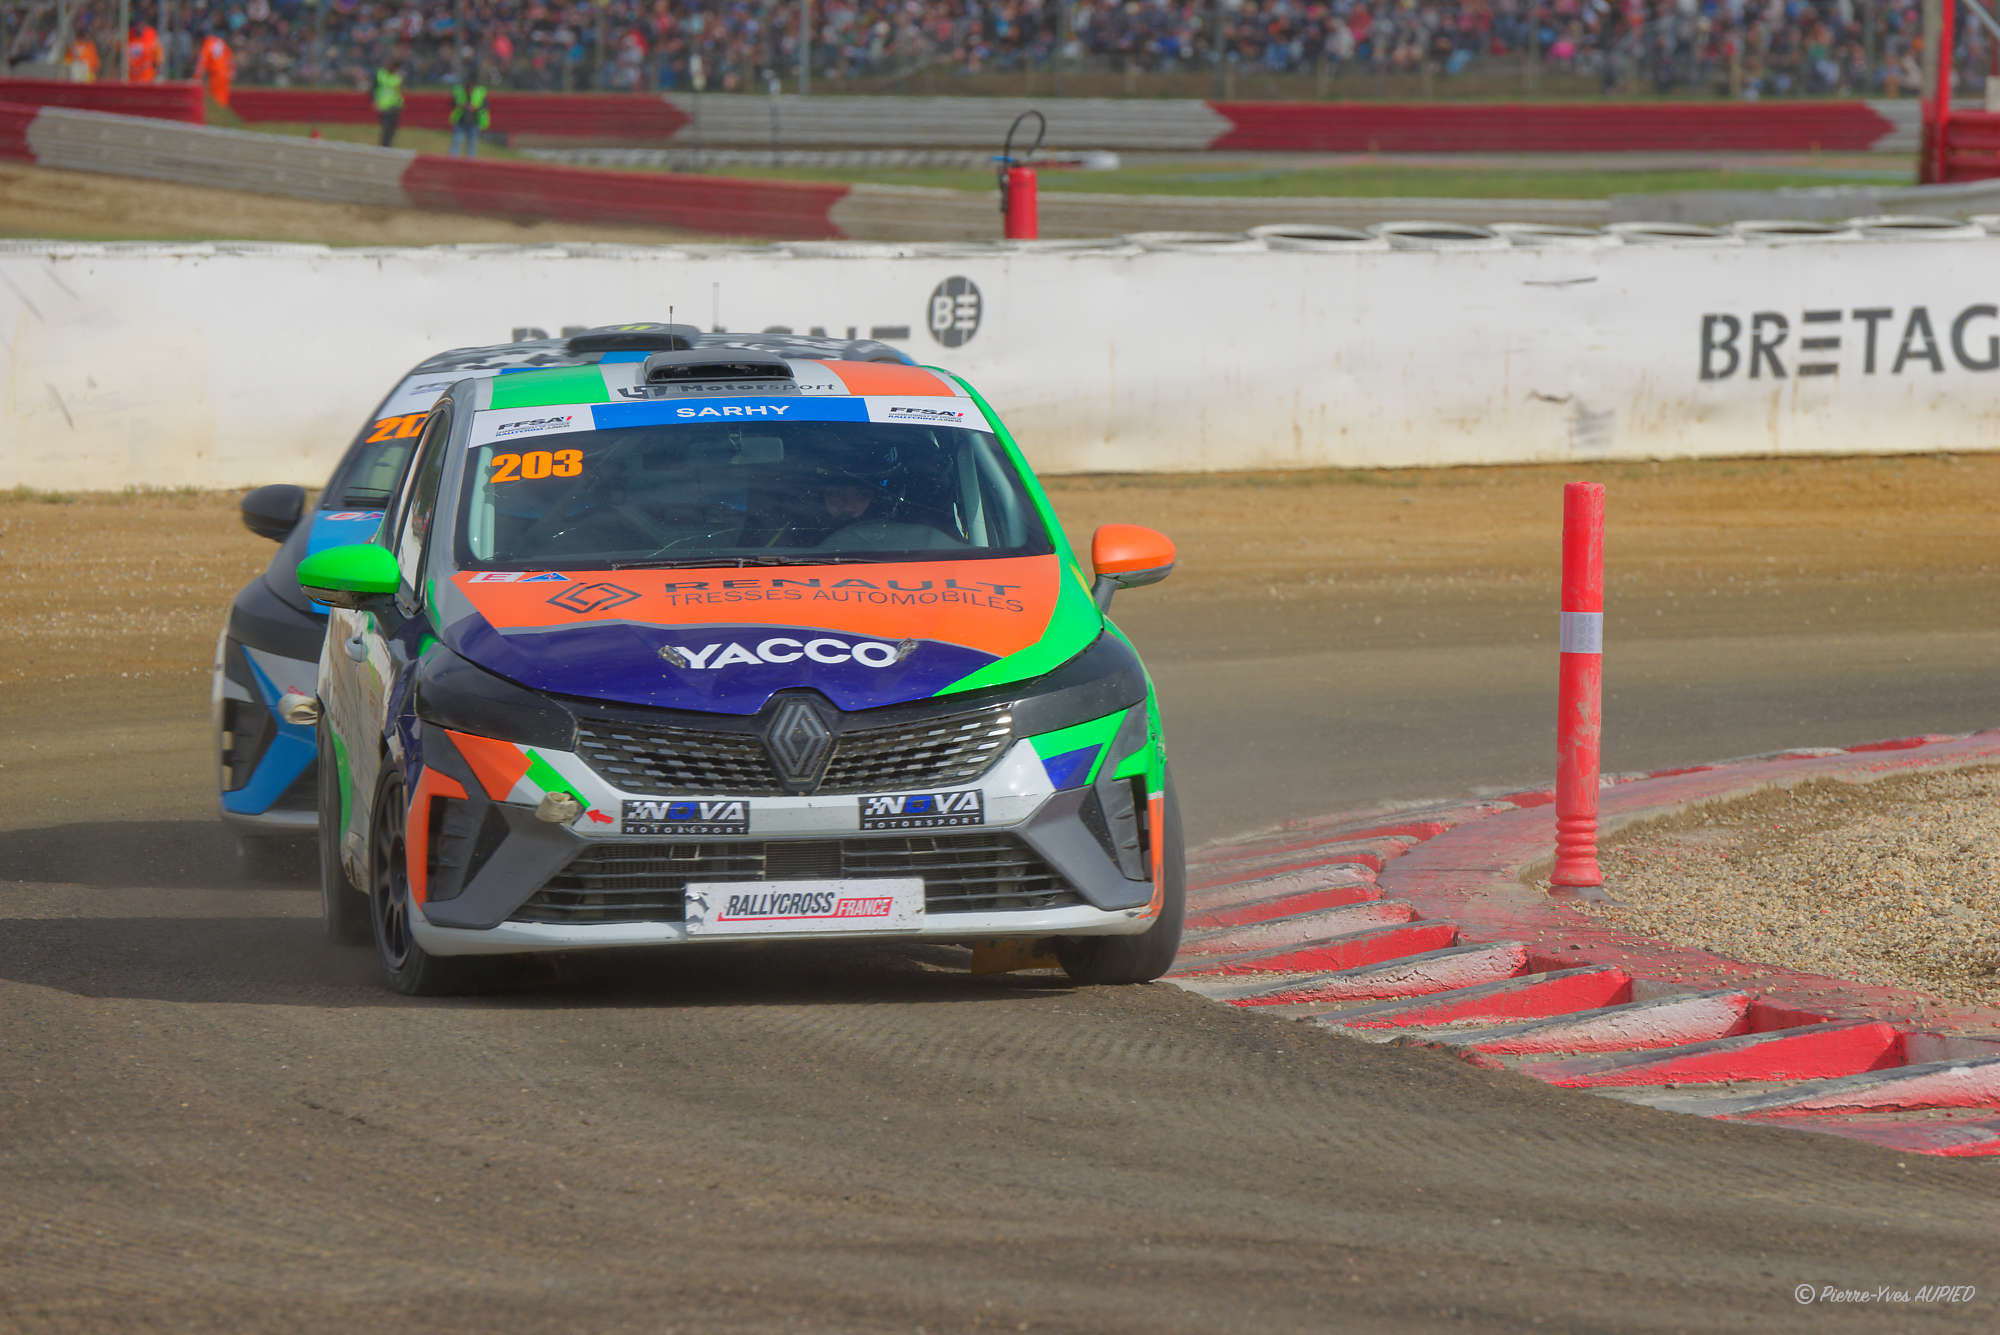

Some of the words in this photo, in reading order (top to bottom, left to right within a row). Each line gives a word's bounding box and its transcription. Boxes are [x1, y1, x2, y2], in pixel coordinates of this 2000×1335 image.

[1700, 303, 2000, 382] BRETAG
[676, 405, 790, 418] SARHY
[490, 449, 583, 483] 203
[665, 578, 1021, 596] RENAULT
[667, 589, 810, 606] TRESSES
[814, 589, 1024, 612] AUTOMOBILES
[675, 638, 898, 669] YACCO
[626, 825, 745, 834] MOTORSPORT
[864, 817, 980, 829] MOTORSPORT
[726, 892, 835, 916] RALLYCROSS
[837, 898, 890, 917] FRANCE
